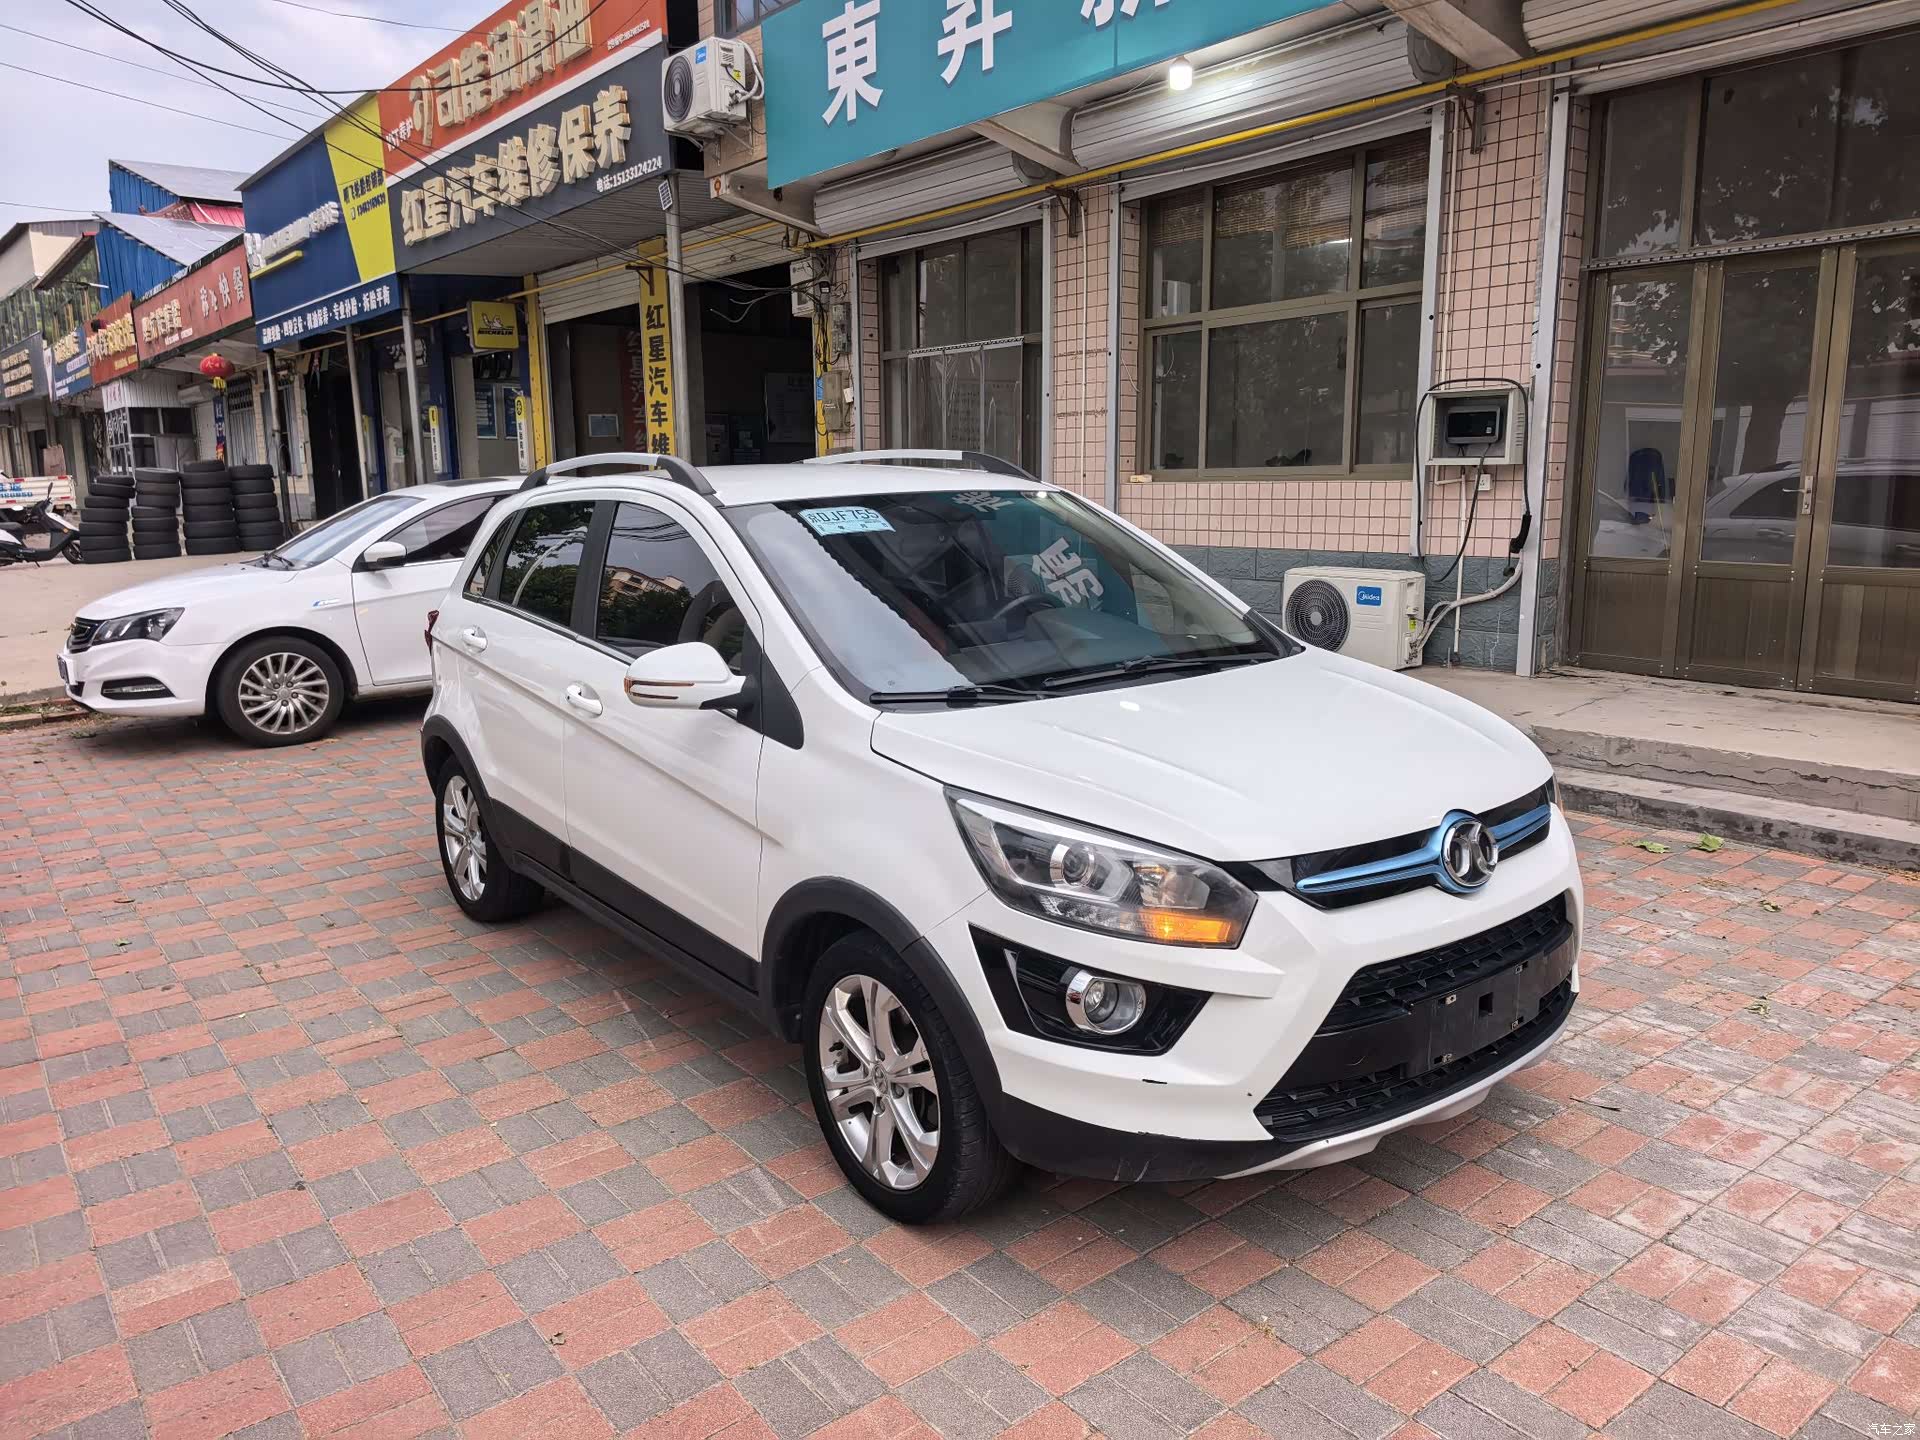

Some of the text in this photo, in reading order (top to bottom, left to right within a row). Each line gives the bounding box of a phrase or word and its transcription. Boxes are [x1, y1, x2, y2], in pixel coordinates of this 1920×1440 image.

[401, 84, 633, 247] 红星汽车维修保养
[1358, 590, 1380, 601] Midea
